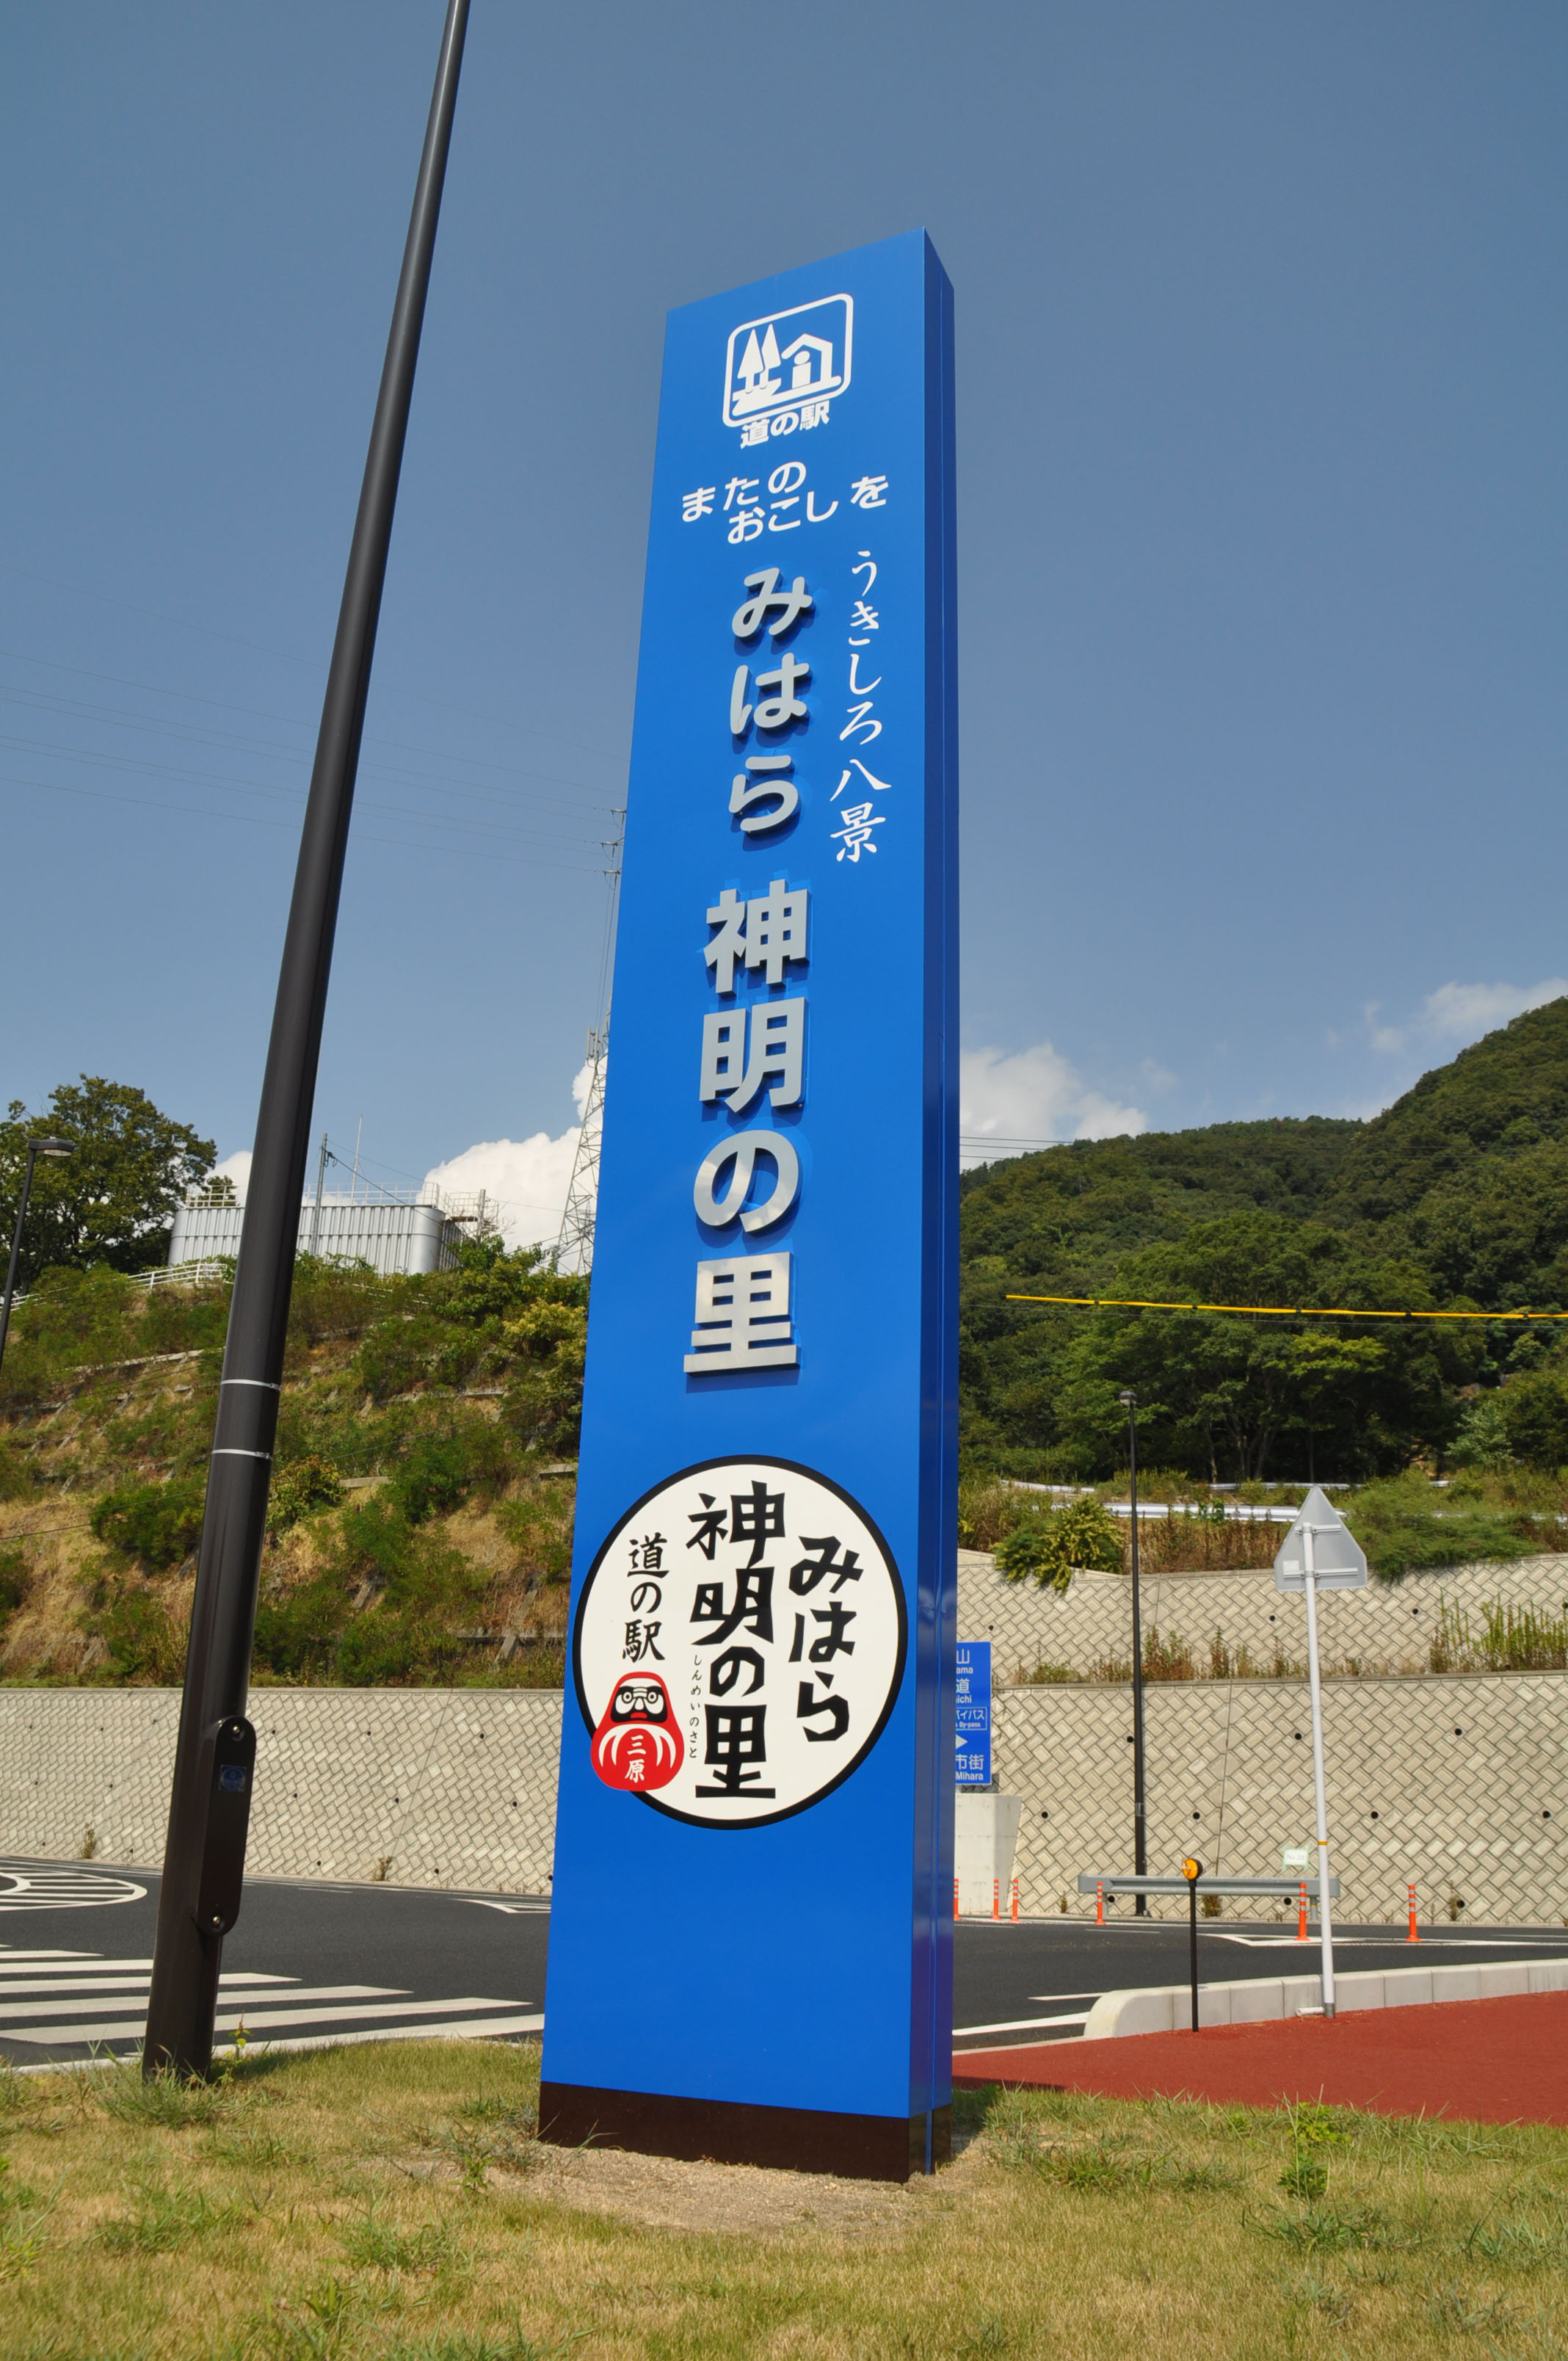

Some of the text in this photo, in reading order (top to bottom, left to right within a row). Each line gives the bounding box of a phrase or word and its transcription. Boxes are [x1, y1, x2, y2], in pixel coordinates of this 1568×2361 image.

[740, 400, 830, 449] 道の駅
[829, 550, 892, 863] うきしろ八景
[683, 567, 813, 1374] みはら 神明の里
[622, 1531, 670, 1664] 道の駅
[685, 1479, 786, 1799] 神明の里
[788, 1535, 865, 1743] みはら
[624, 1735, 647, 1783] 三原
[689, 1654, 703, 1759] しんめいのさと
[956, 1771, 984, 1781] Mihara
